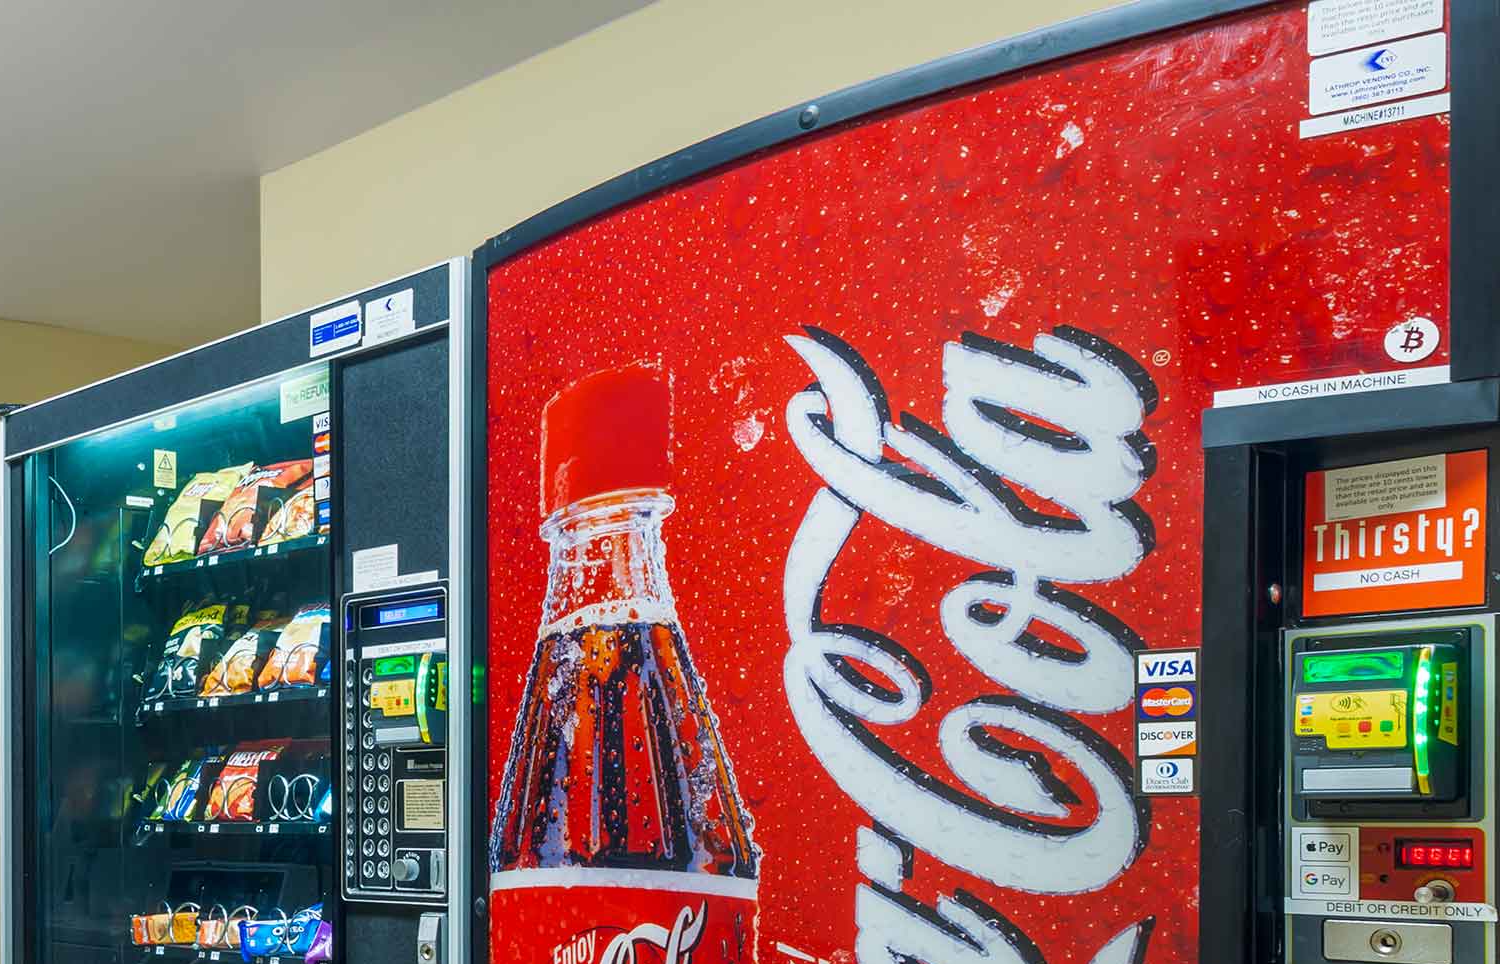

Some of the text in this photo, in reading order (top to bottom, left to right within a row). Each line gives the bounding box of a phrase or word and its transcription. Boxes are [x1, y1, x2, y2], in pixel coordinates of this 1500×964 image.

[1362, 73, 1396, 85] VENDING
[1343, 106, 1405, 125] MACHINE#13711
[1258, 374, 1407, 400] NO CASH IN MACHINE
[315, 416, 330, 429] VIS
[1313, 507, 1480, 562] Thirsty?
[1360, 569, 1420, 584] NO CASH
[1144, 659, 1194, 677] VISA
[1140, 730, 1194, 741] DISCOVER
[1170, 777, 1190, 786] Club
[1319, 841, 1344, 856] Pay
[1322, 873, 1345, 889] Pay
[1326, 902, 1483, 917] DEBIT OR CREDIT ONLY
